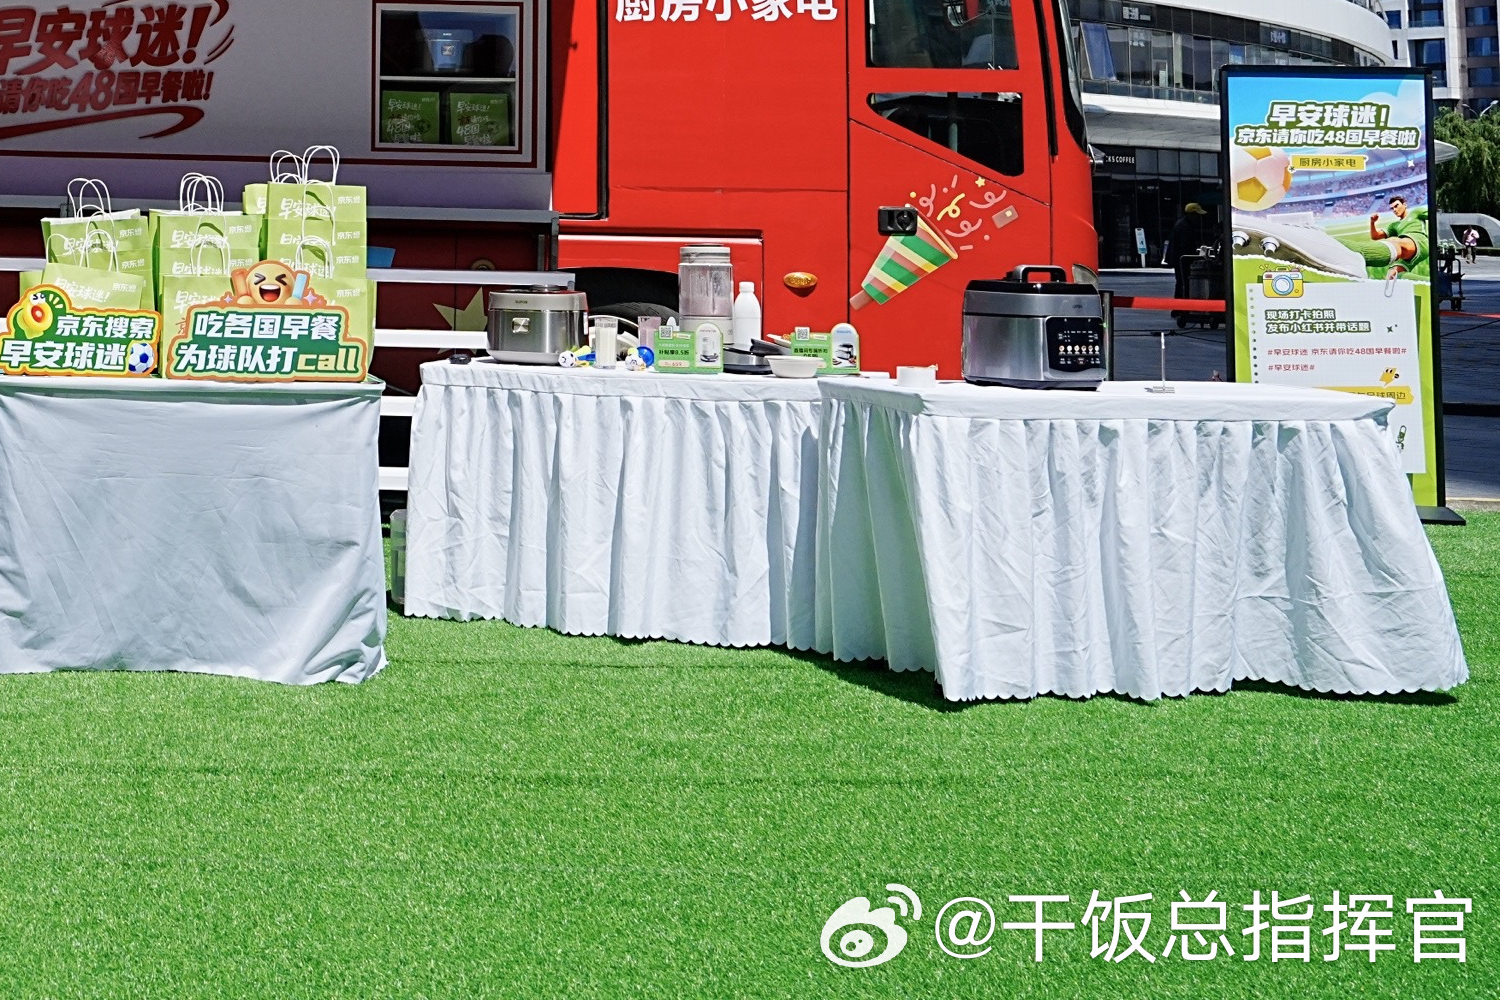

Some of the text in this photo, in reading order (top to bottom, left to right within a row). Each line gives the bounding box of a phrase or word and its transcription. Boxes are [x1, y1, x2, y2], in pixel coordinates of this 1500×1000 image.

[1269, 104, 1387, 127] 早安球迷!
[1237, 129, 1417, 146] 京东请你吃48国早餐啦
[1299, 157, 1357, 167] 厨房小家电
[1265, 310, 1335, 320] 现场打卡拍照
[55, 315, 155, 340] 京东搜索
[194, 313, 340, 341] 吃各国早餐
[1266, 321, 1371, 333] 发布小红书并带话题
[0, 340, 127, 372] 早安球迷
[177, 346, 357, 374] 为球队打call
